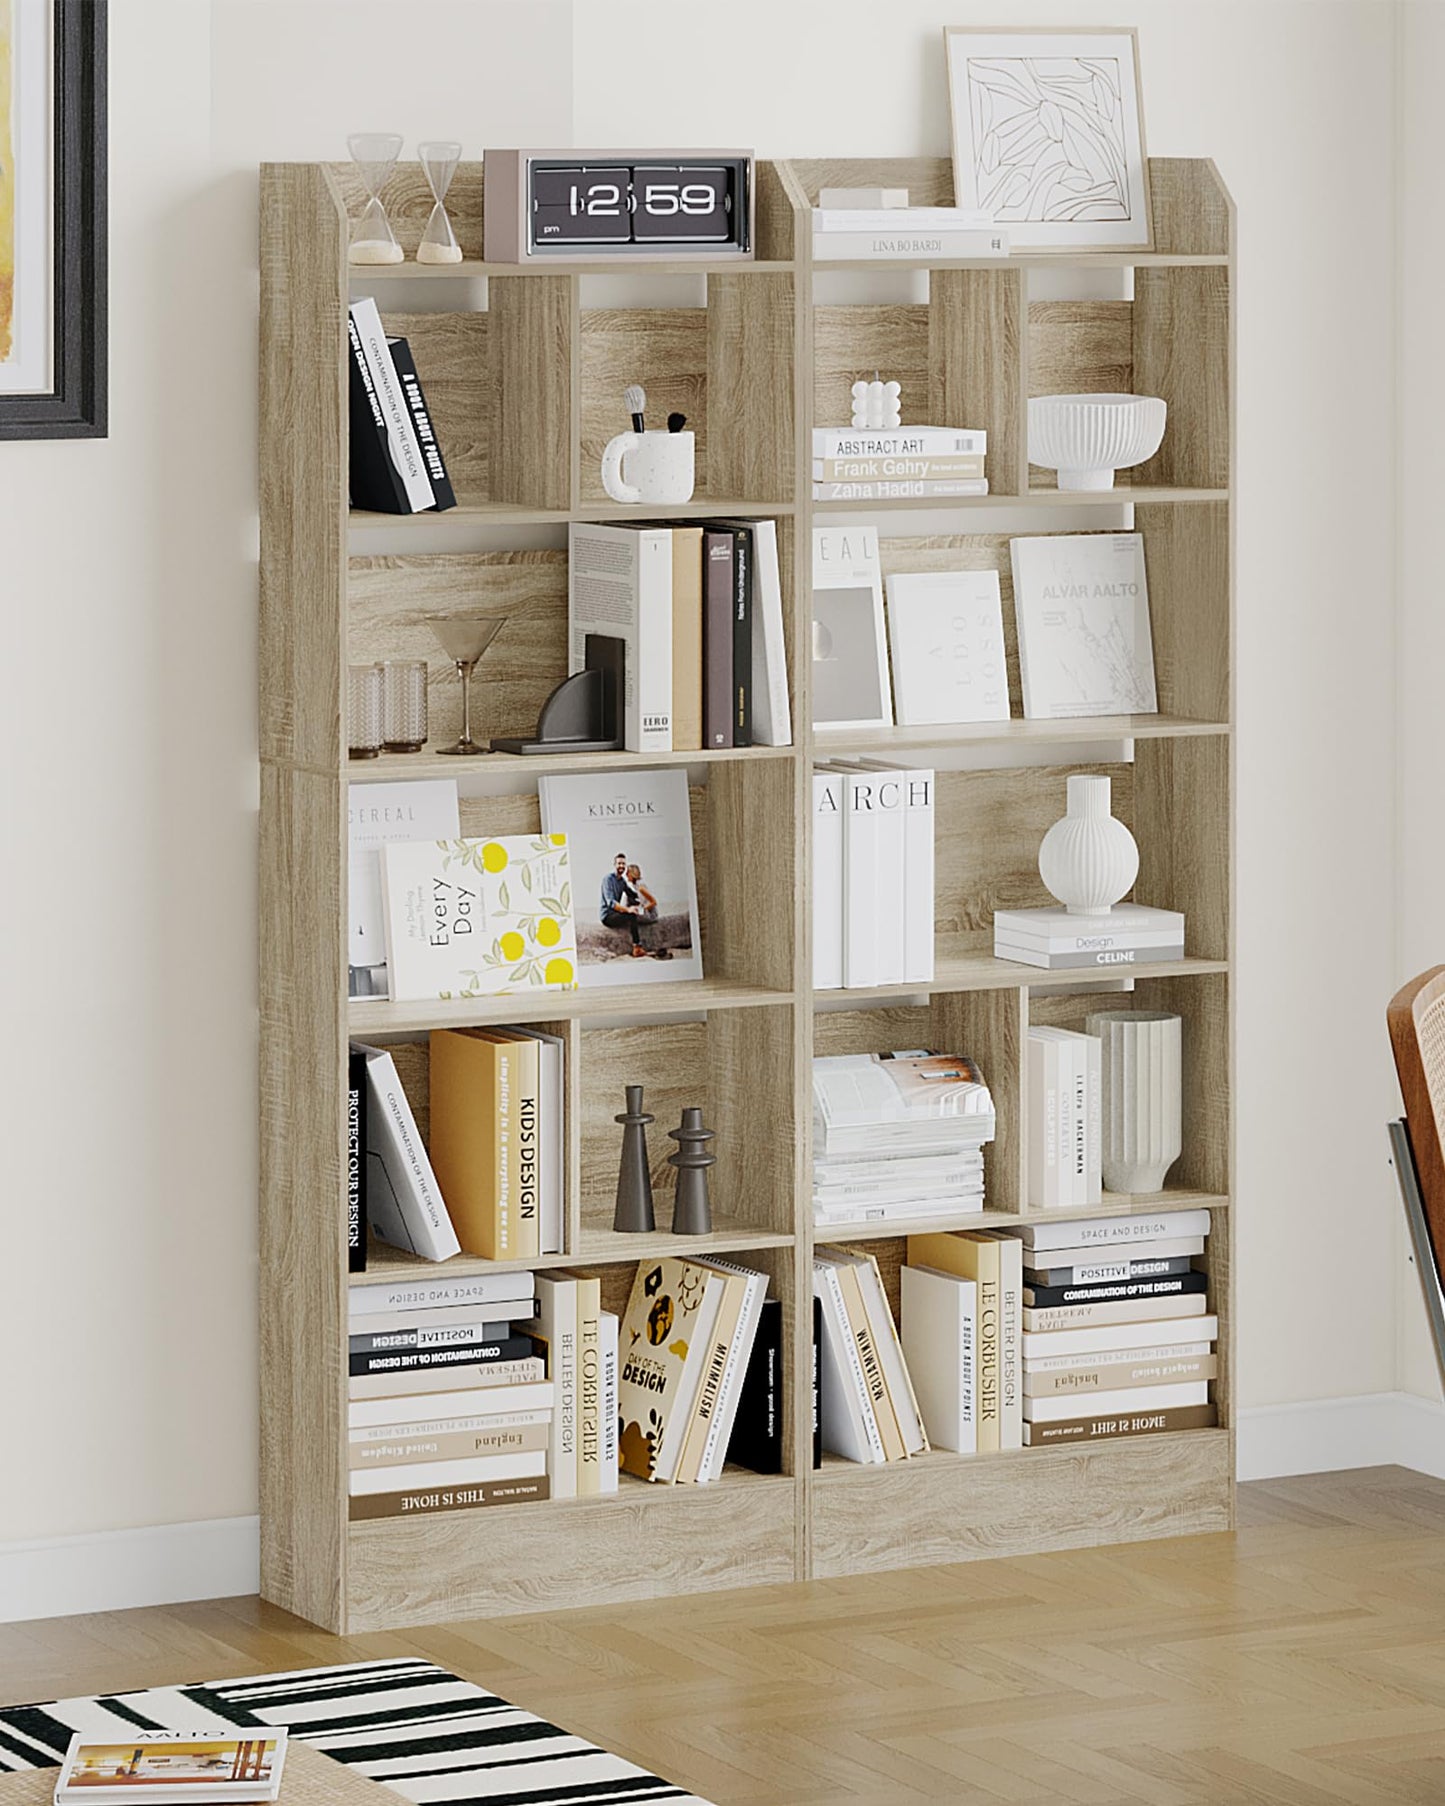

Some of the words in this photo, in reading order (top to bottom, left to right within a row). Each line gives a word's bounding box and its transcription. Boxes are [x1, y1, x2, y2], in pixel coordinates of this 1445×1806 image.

[570, 184, 620, 216] 12
[645, 184, 716, 216] 59
[544, 225, 560, 234] pm
[872, 240, 896, 252] LINA
[898, 240, 911, 252] BO
[912, 240, 942, 252] BARDI
[348, 320, 361, 351] OPEN
[355, 351, 374, 392] DESIGN
[368, 393, 384, 428] NIGHT
[370, 337, 397, 412] CONTAMINATION
[392, 412, 401, 423] OF
[397, 426, 406, 444] THE
[402, 445, 418, 478] DESIGN
[406, 383, 423, 410] BOOK
[414, 412, 434, 443] ABOUT
[836, 440, 898, 454] ABSTRACT
[901, 439, 925, 453] ART
[834, 460, 878, 477] Frank
[882, 459, 930, 478] Gehry
[832, 482, 873, 498] Zaha
[877, 481, 924, 496] Hadid
[1042, 584, 1088, 600] ALVAR
[1092, 583, 1138, 598] AALTO
[643, 717, 668, 726] EERO
[588, 801, 656, 816] KINFOLK
[430, 878, 452, 946] Every
[453, 886, 476, 935] Day
[1076, 936, 1114, 950] Design
[1096, 951, 1135, 964] CELINE
[500, 1056, 509, 1114] simplicity
[348, 1090, 359, 1157] PROTECT
[500, 1116, 508, 1128] is
[520, 1098, 535, 1143] KIDS
[501, 1131, 508, 1142] in
[387, 1092, 416, 1165] CONTAMINATION
[413, 1164, 422, 1178] OF
[418, 1178, 428, 1194] THE
[424, 1194, 440, 1228] DESIGN
[348, 1157, 359, 1191] OUR
[499, 1146, 509, 1208] everything
[520, 1148, 535, 1218] DESIGN
[348, 1193, 359, 1248] DESIGN
[501, 1212, 508, 1226] we
[1081, 1228, 1109, 1239] SPACE
[1112, 1227, 1130, 1236] AND
[1134, 1224, 1166, 1235] DESIGN
[1080, 1266, 1129, 1278] POSITIVE
[1131, 1262, 1170, 1275] DESIGN
[982, 1282, 996, 1304] LE
[1063, 1284, 1126, 1300] CONTAMINATION
[1126, 1284, 1138, 1296] OF
[1138, 1283, 1154, 1294] THE
[1154, 1280, 1182, 1294] DESIGN
[1004, 1291, 1015, 1345] BETTER
[628, 1352, 642, 1365] DAY
[642, 1358, 652, 1368] OF
[652, 1362, 666, 1376] THE
[982, 1310, 996, 1422] CORBUSIER
[622, 1363, 667, 1394] DESIGN
[699, 1343, 728, 1420] MINIMALISM
[1004, 1350, 1015, 1407] DESIGN
[475, 1434, 523, 1450] England
[402, 1495, 440, 1510] HOME
[442, 1493, 453, 1505] IS
[456, 1490, 486, 1502] THIS
